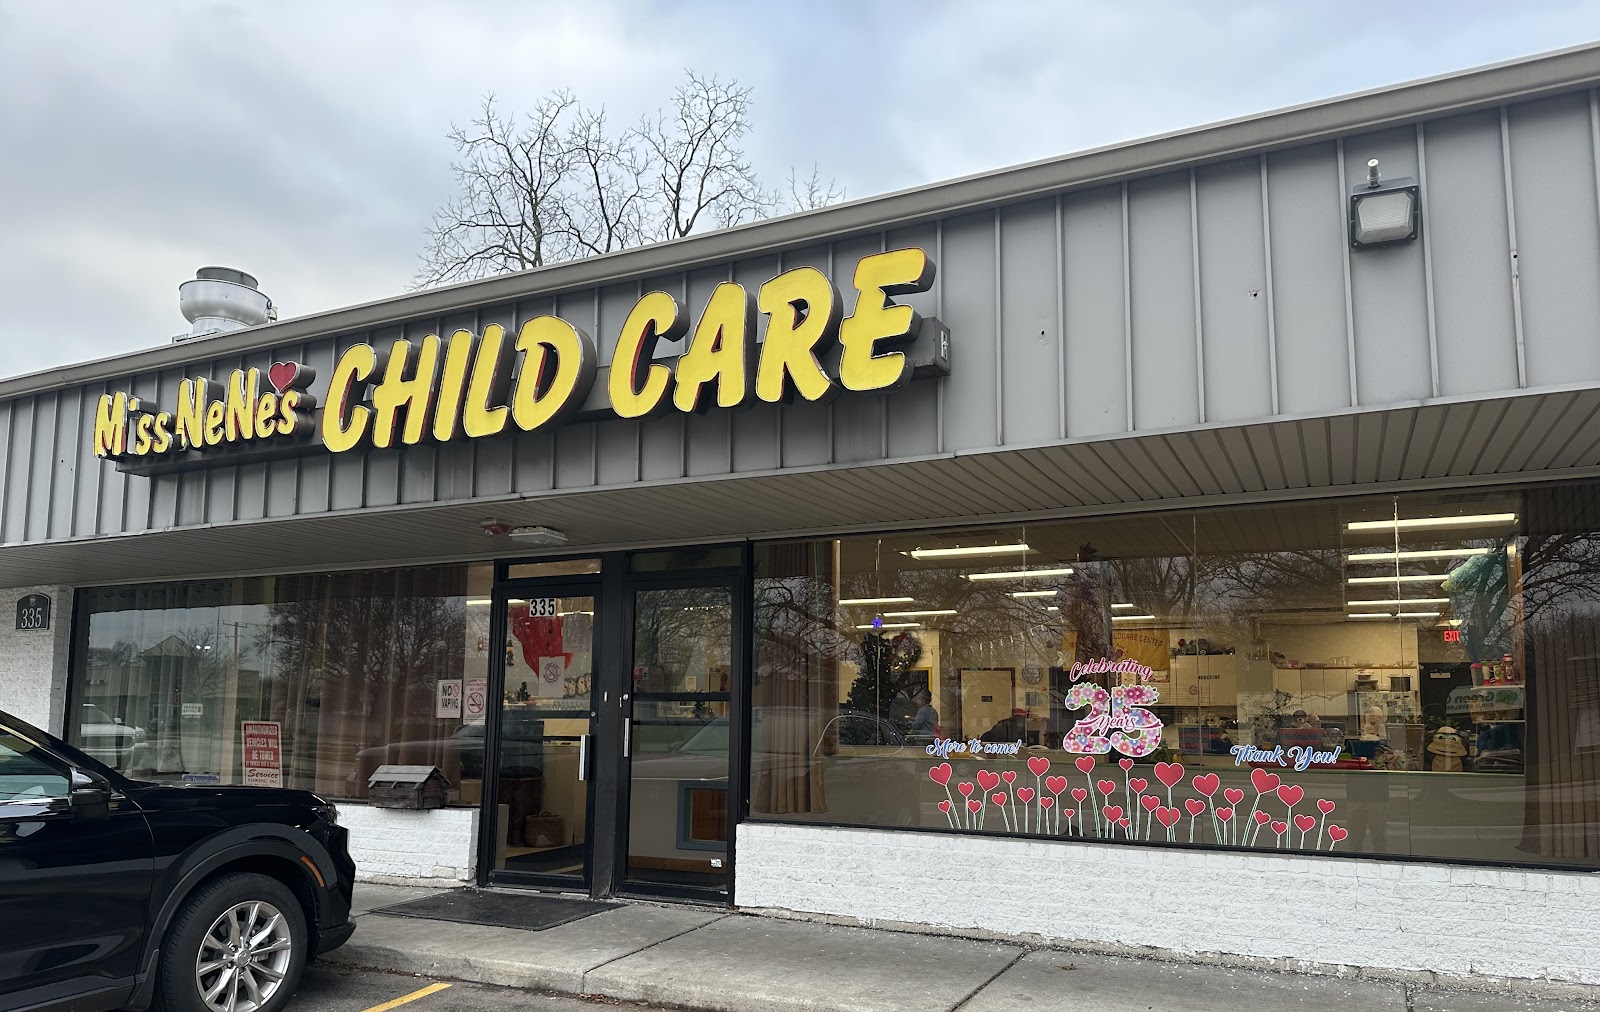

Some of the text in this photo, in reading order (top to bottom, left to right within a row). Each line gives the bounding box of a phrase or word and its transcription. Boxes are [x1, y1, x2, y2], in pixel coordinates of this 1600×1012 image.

[94, 391, 171, 457] Miss
[322, 315, 584, 453] CHILD
[608, 247, 928, 419] CARE
[21, 607, 42, 629] 335
[530, 598, 555, 617] 335
[1139, 634, 1164, 648] CENTER
[1443, 630, 1460, 642] EXIT
[1069, 657, 1154, 682] Celebrating
[442, 685, 453, 697] NO
[1063, 682, 1162, 757] 25
[1097, 714, 1137, 737] Years
[926, 738, 1022, 760] More to come!
[1230, 745, 1342, 772] Thank You!
[247, 768, 279, 779] Service
